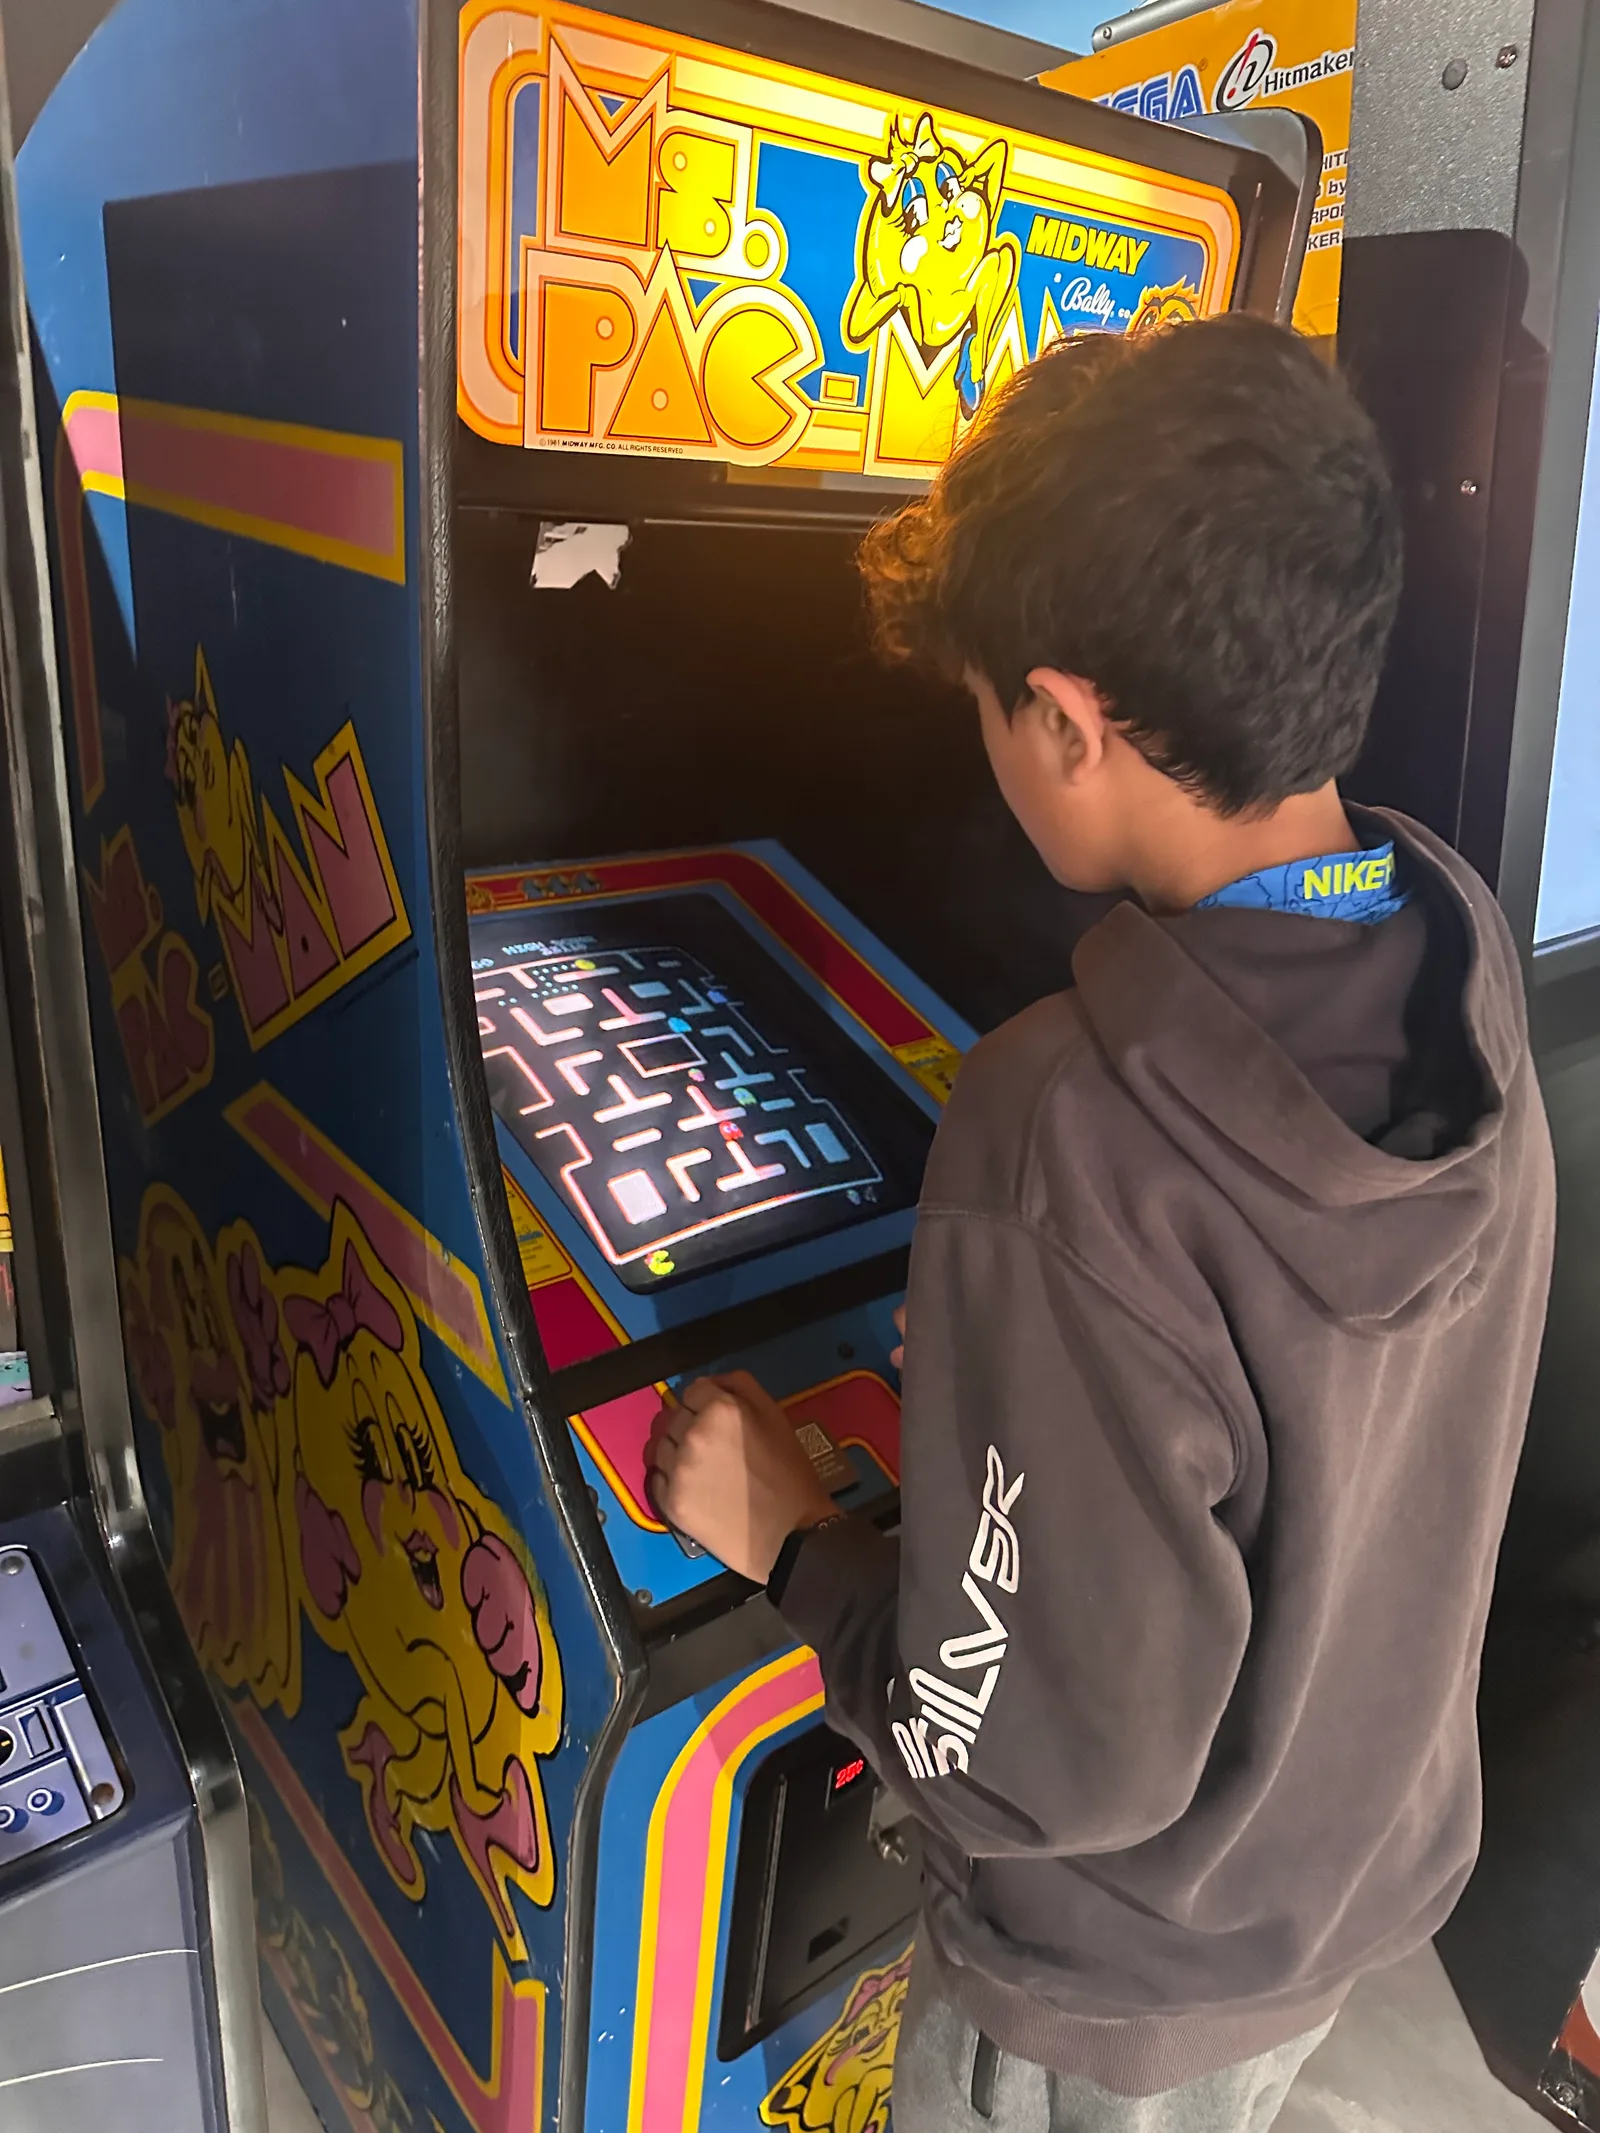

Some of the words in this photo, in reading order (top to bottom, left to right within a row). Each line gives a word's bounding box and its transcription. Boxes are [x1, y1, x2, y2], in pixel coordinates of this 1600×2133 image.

[1097, 68, 1204, 121] EGA
[1024, 213, 1151, 276] MIDWAY
[1307, 231, 1340, 251] KER
[562, 440, 588, 448] MIDWAY
[630, 444, 652, 453] RIGHTS
[653, 446, 684, 454] RESERVED
